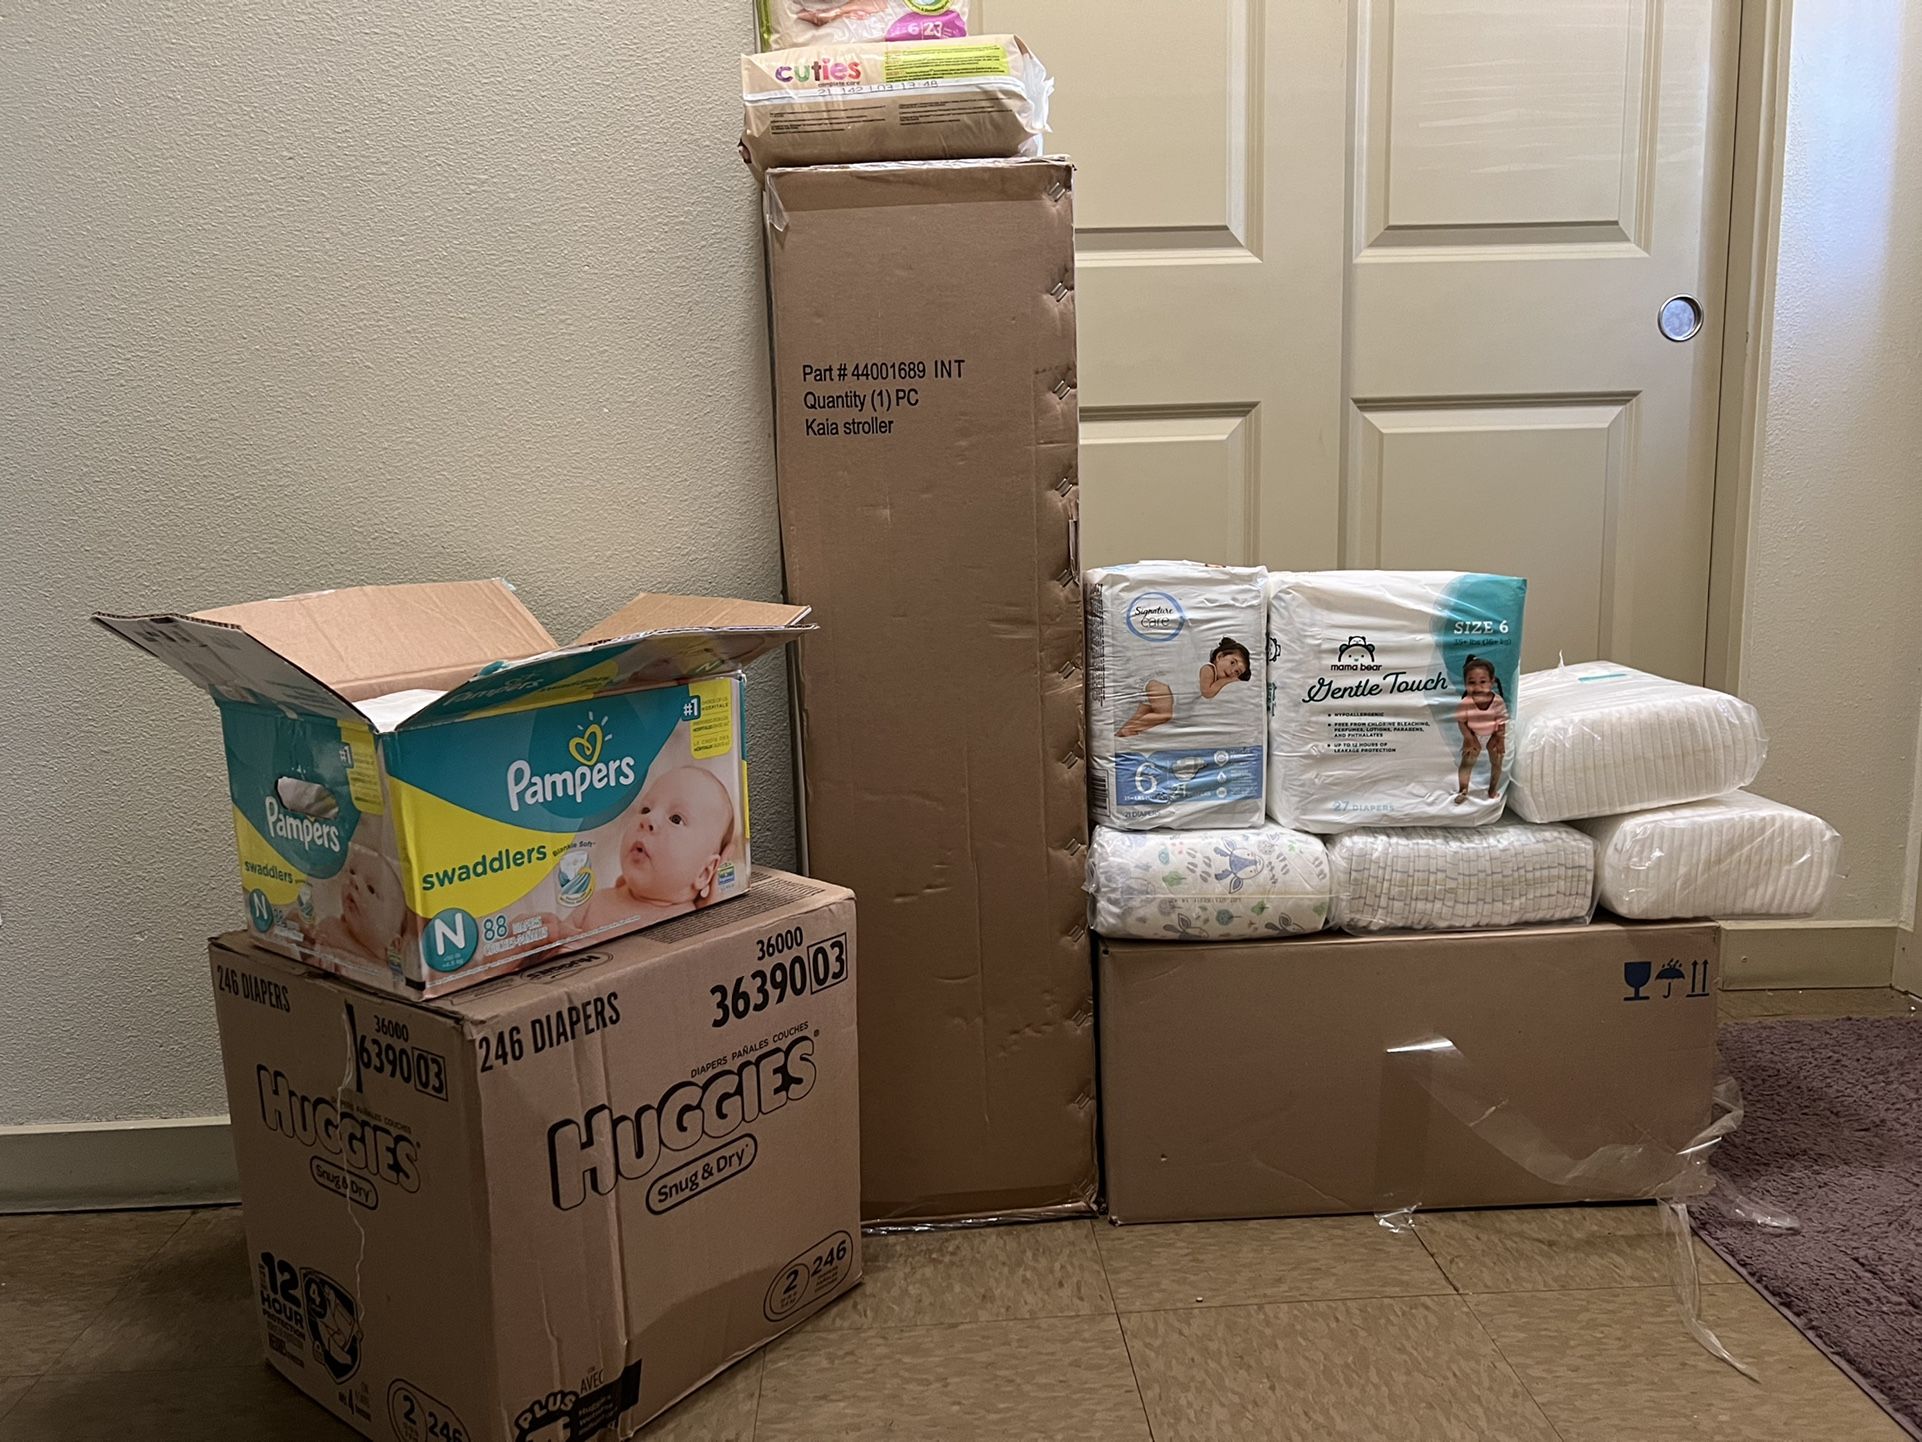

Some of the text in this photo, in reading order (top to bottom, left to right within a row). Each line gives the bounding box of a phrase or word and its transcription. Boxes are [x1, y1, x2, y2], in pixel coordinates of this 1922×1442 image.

[774, 57, 862, 83] cuties
[803, 359, 965, 382] Part # 44001689 INT
[803, 388, 919, 411] Quantity (1) PC
[805, 417, 894, 436] Kaia stroller
[1134, 606, 1174, 618] Signature
[1454, 620, 1509, 634] SIZE 6
[1330, 663, 1382, 672] mama bear
[1302, 677, 1382, 704] Gentle
[1382, 671, 1449, 695] Touch
[683, 698, 698, 716] #1
[507, 756, 635, 812] Pampers
[265, 796, 340, 852] Pampers
[1333, 801, 1394, 812] 27 DIAPERS
[244, 860, 294, 884] swaddlers
[422, 842, 548, 891] swaddlers
[252, 891, 268, 920] N
[434, 912, 465, 955] N
[484, 914, 507, 941] 88
[755, 926, 804, 960] 36000
[217, 965, 290, 1012] 246 DIAPERS
[709, 940, 846, 1028] 36390 03
[374, 1015, 409, 1041] 36000
[478, 991, 621, 1073] 246 DIAPERS
[358, 1034, 445, 1094] 6390 03
[690, 1021, 809, 1079] DIAPERS PAÑALES COUCHES
[256, 1064, 422, 1194] HUGGIES
[547, 1034, 817, 1211] HUGGIES
[315, 1163, 342, 1190] Snug
[350, 1181, 373, 1201] Dry
[657, 1147, 746, 1204] Snug & Dry
[811, 1239, 847, 1277] 246
[260, 1251, 302, 1309] 12
[782, 1269, 799, 1295] 2
[261, 1290, 305, 1329] HOUR
[402, 1395, 417, 1424] 2
[518, 1392, 577, 1429] PLUS
